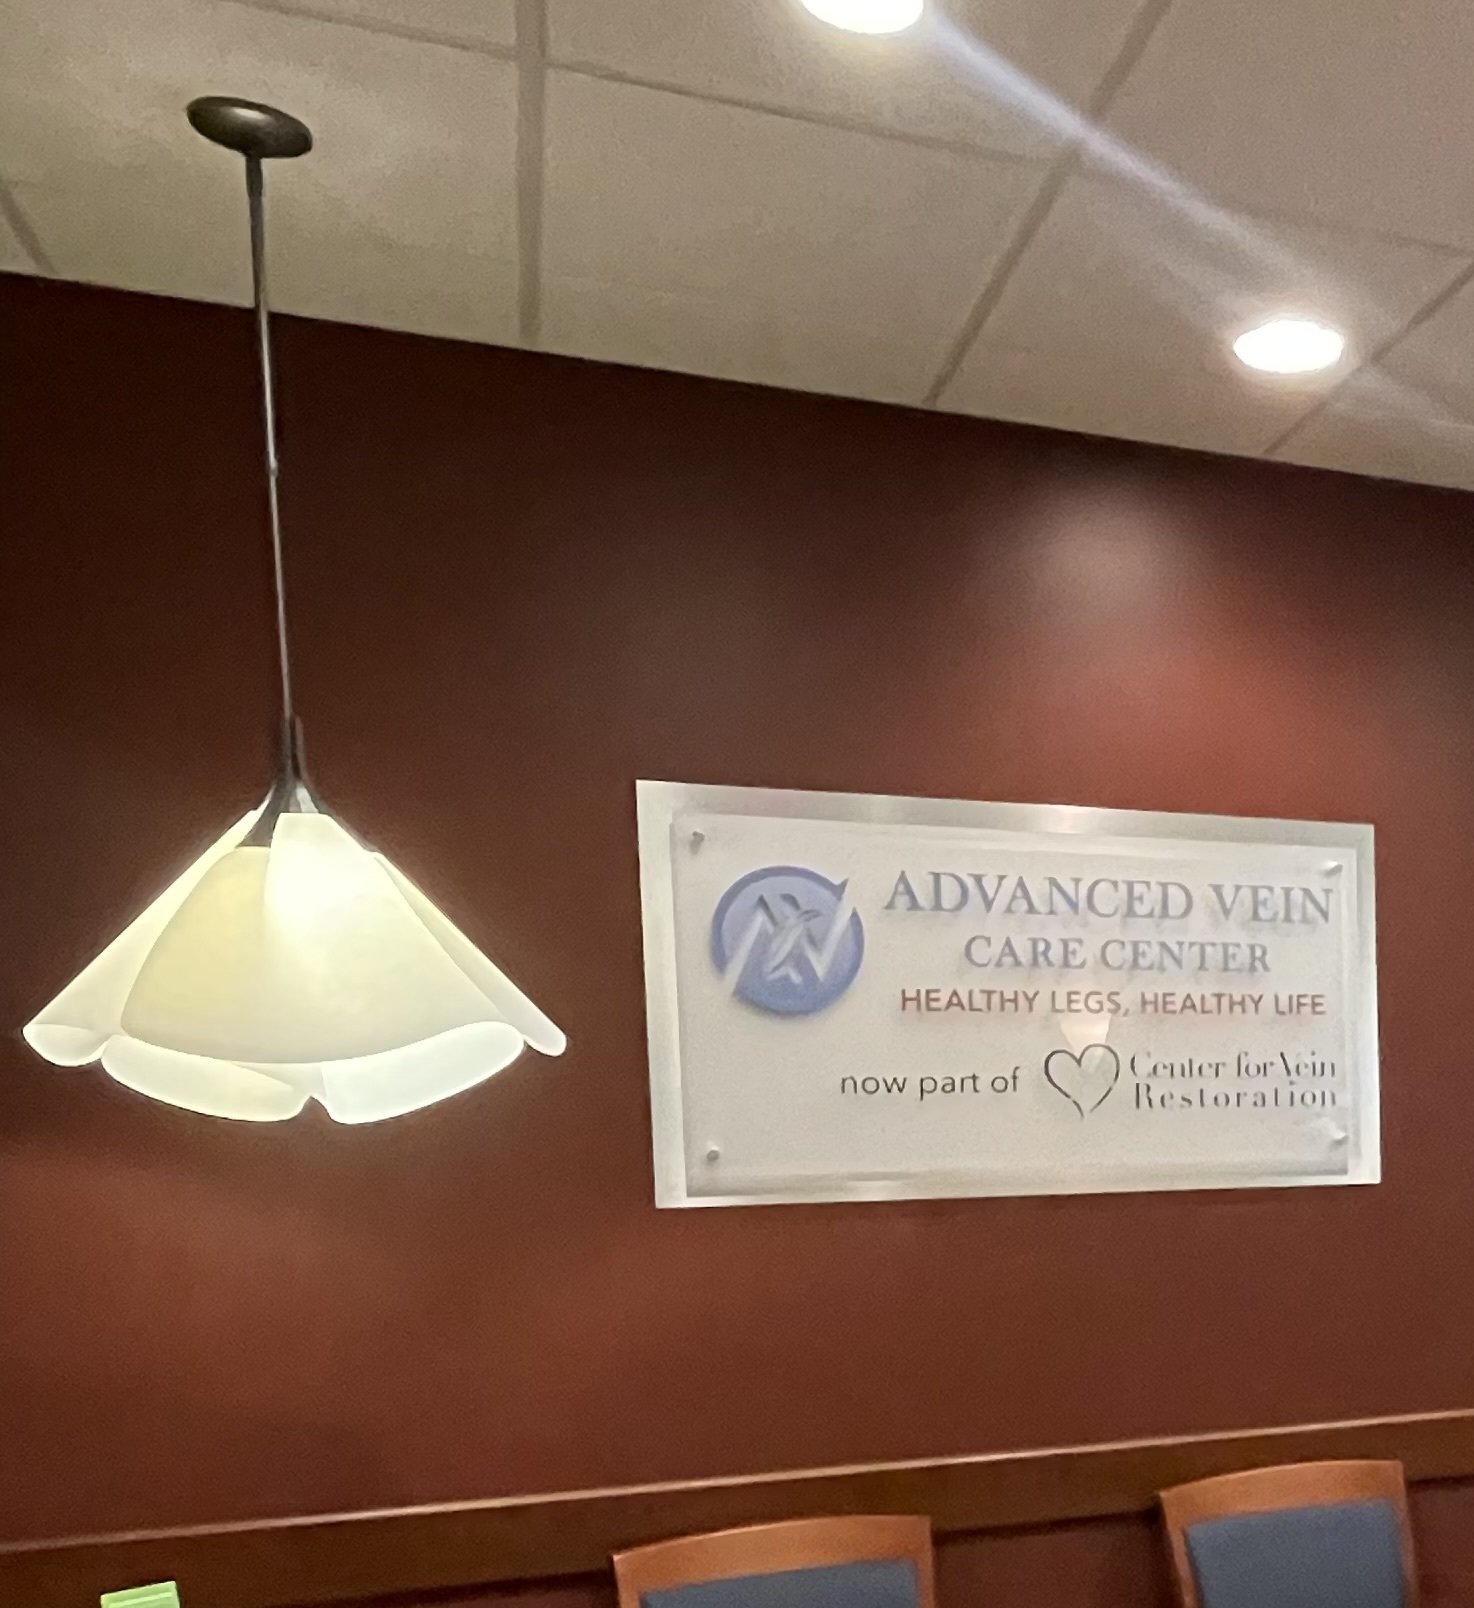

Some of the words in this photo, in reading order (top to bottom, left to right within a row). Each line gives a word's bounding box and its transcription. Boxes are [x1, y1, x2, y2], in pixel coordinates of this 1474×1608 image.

[882, 870, 1194, 919] ADVANCED
[1208, 883, 1334, 924] VEIN
[964, 935, 1087, 969] CARE
[1100, 939, 1271, 973] CENTER
[901, 988, 1040, 1012] HEALTHY
[1051, 990, 1129, 1017] LEGS,
[1140, 991, 1264, 1015] HEALTHY
[1274, 992, 1327, 1016] LIFE
[1130, 1051, 1226, 1079] Center
[1237, 1051, 1275, 1078] for
[841, 1076, 907, 1095] now
[919, 1073, 980, 1101] part
[991, 1066, 1020, 1094] of
[1135, 1080, 1336, 1109] Restoration
